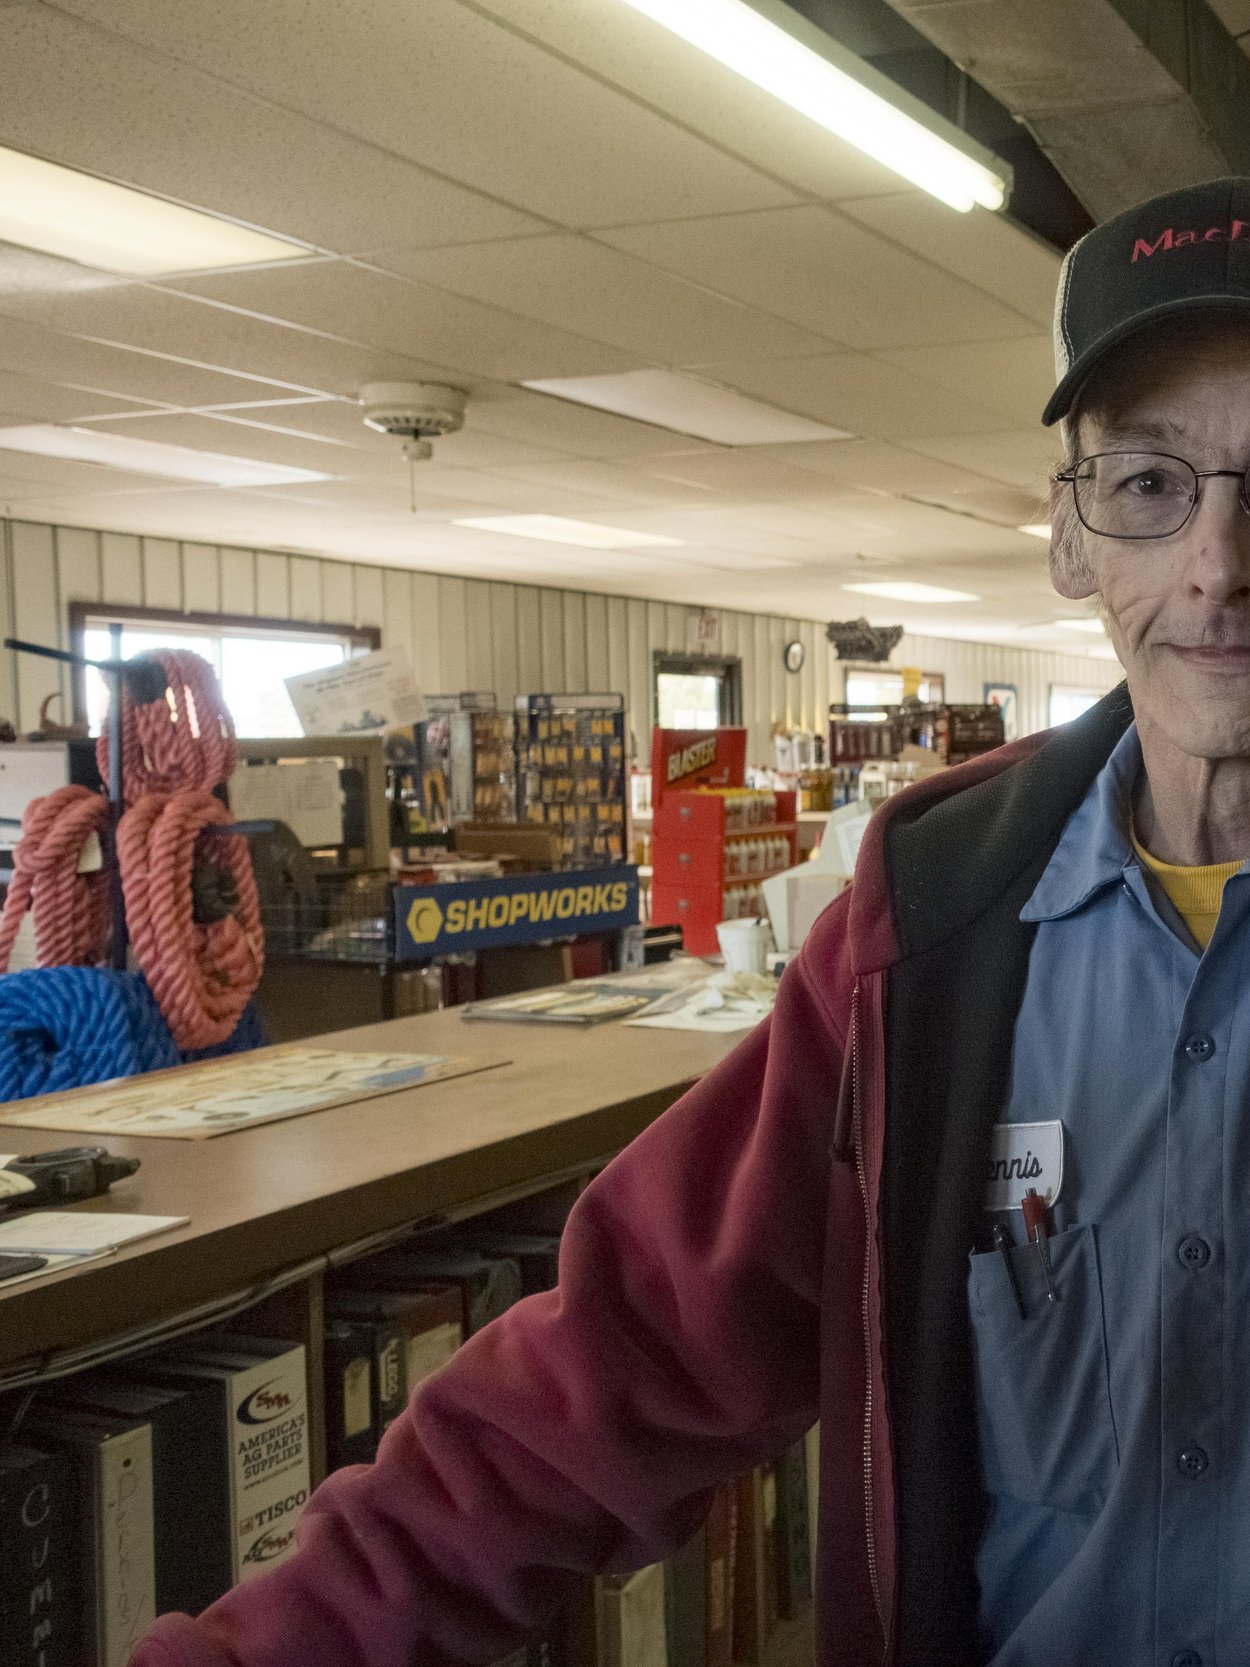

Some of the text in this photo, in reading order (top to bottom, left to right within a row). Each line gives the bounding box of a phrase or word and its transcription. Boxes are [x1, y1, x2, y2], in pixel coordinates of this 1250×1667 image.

[445, 882, 628, 934] SHOPWORKS
[238, 1413, 306, 1455] AMERICA'S
[242, 1430, 303, 1467] AG PARTS
[244, 1443, 303, 1480] SUPPLIER
[255, 1489, 307, 1527] TISCO
